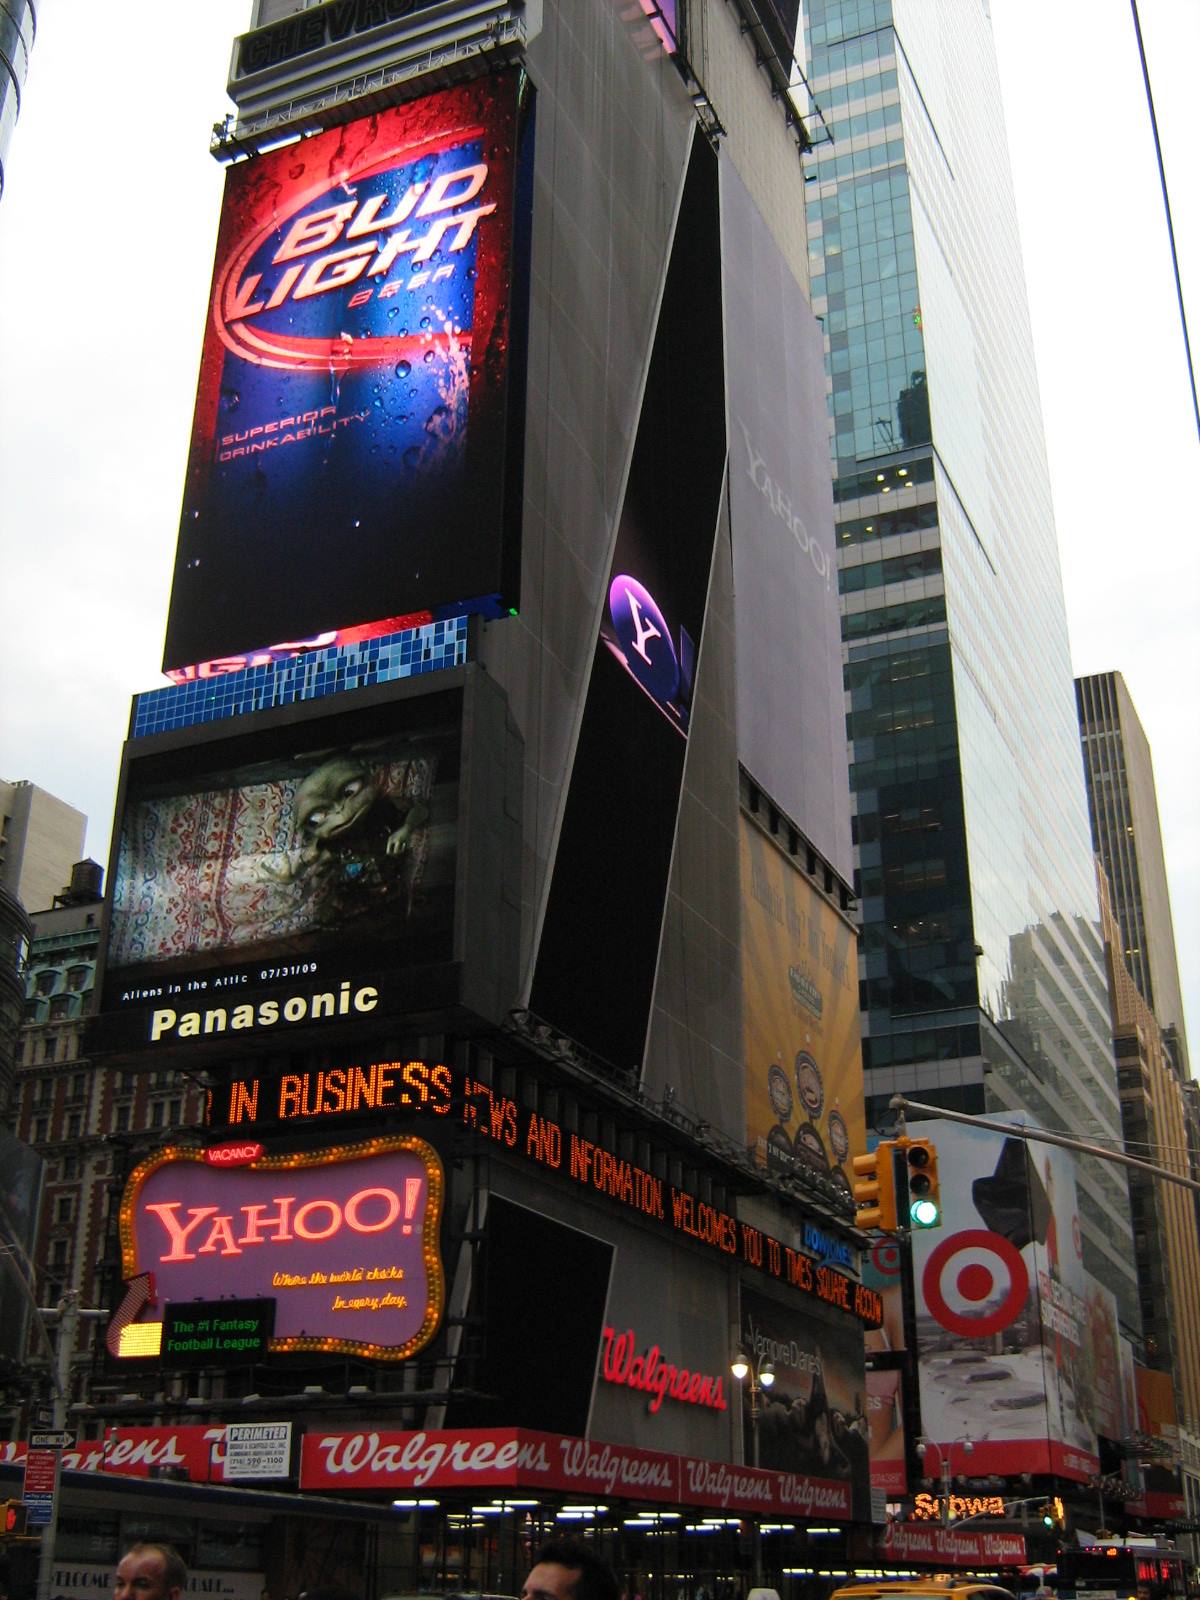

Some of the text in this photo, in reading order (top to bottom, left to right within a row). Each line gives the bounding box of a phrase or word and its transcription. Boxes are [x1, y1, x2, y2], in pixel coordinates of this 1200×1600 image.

[272, 163, 489, 265] BUD
[224, 203, 497, 323] LIGHT
[348, 264, 456, 309] BEER
[219, 409, 370, 462] DRINKABILITY
[222, 405, 337, 446] SUPERIOR
[122, 962, 317, 1001] Aliens in the Attic 07/31/09
[151, 982, 378, 1041] Panasonic
[229, 1079, 260, 1125] IN
[279, 1061, 453, 1119] BUSINESS
[207, 1143, 261, 1162] VACANCY
[145, 1178, 422, 1262] YAHOO!
[526, 1112, 562, 1169] AND
[671, 1187, 737, 1255] WELCOMES
[741, 1224, 763, 1267] YOU
[767, 1237, 781, 1276] TO
[785, 1247, 813, 1291] TIMES
[816, 1266, 851, 1312] SQUARE
[167, 1336, 261, 1352] Football League
[173, 1319, 259, 1333] The #1 Fantasy
[602, 1327, 727, 1414] Walgreens
[35, 1435, 49, 1444] ONE
[231, 1426, 288, 1441] PERIMETER
[319, 1432, 550, 1486] Walgreens
[559, 1438, 673, 1495] Walgreens
[686, 1460, 774, 1507] Walgreens
[777, 1475, 848, 1516] Walgreens
